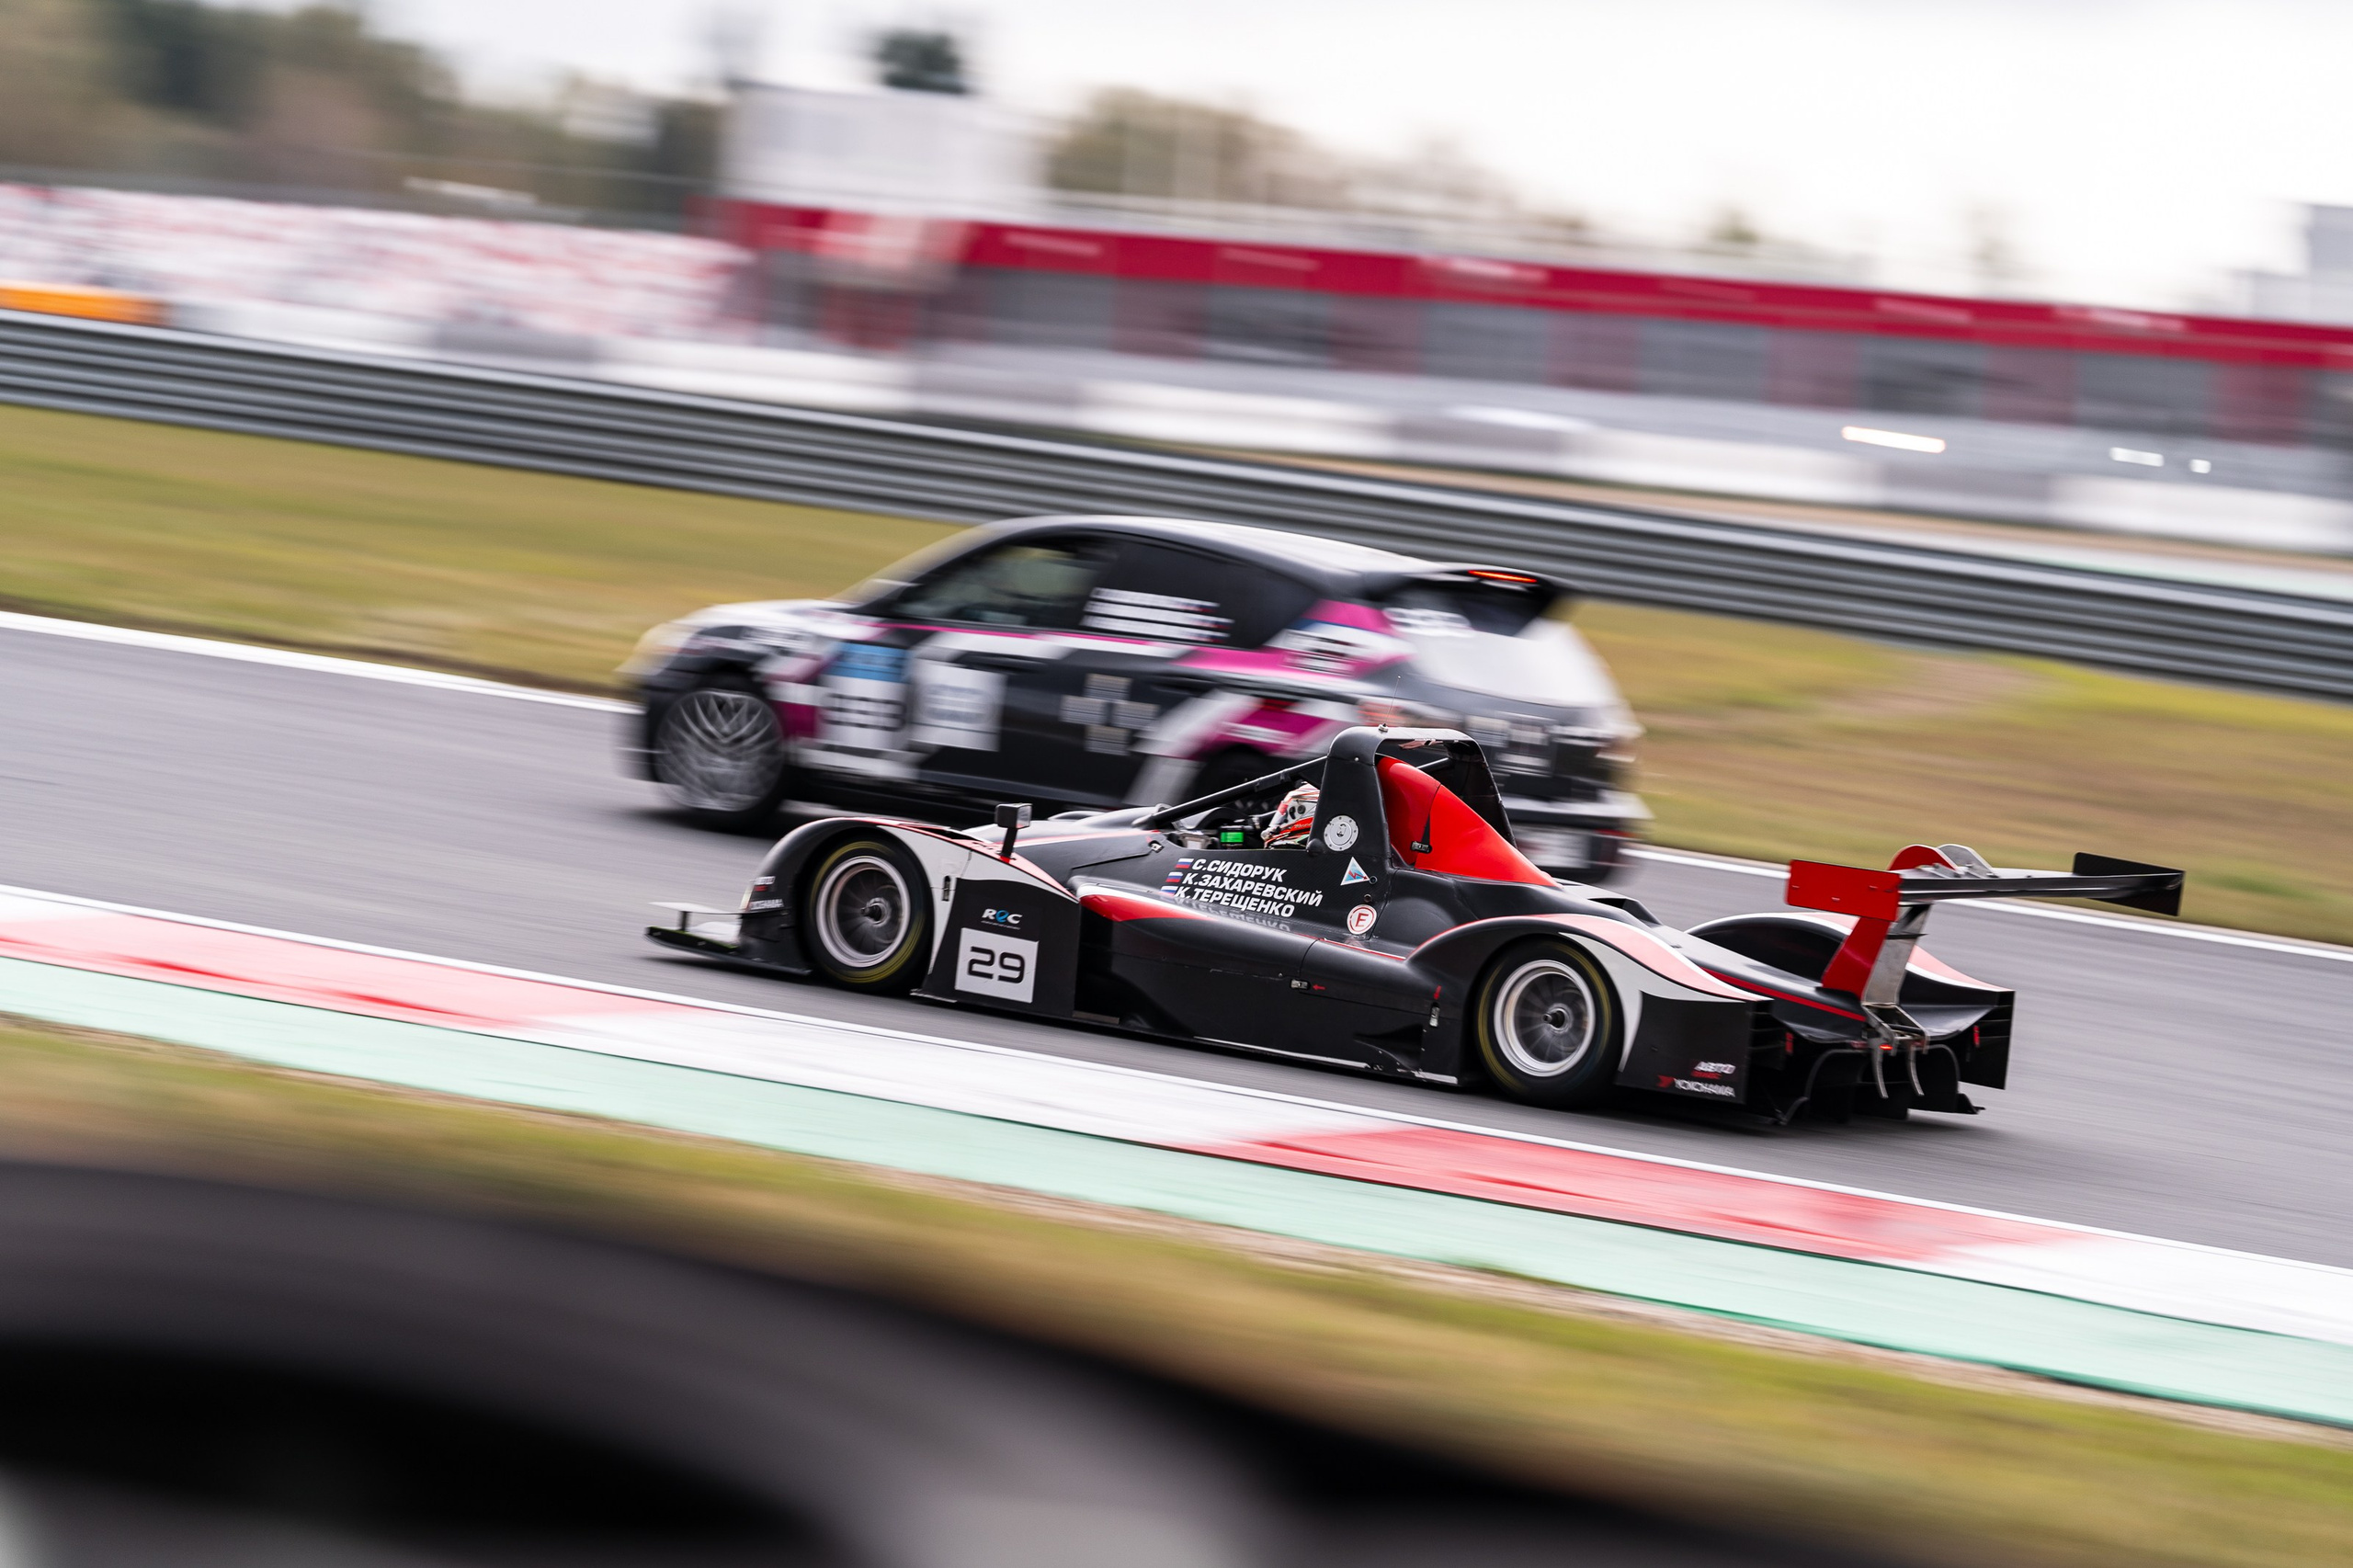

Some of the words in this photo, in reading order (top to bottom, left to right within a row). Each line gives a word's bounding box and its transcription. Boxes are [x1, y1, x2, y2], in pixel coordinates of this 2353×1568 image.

[1192, 858, 1287, 882] С.СИДОРУК
[1175, 886, 1295, 917] К.ТЕРЕЩЕНКО
[1182, 872, 1324, 907] К.ЗАХАРЕВСКИЙ
[968, 946, 1025, 983] 29
